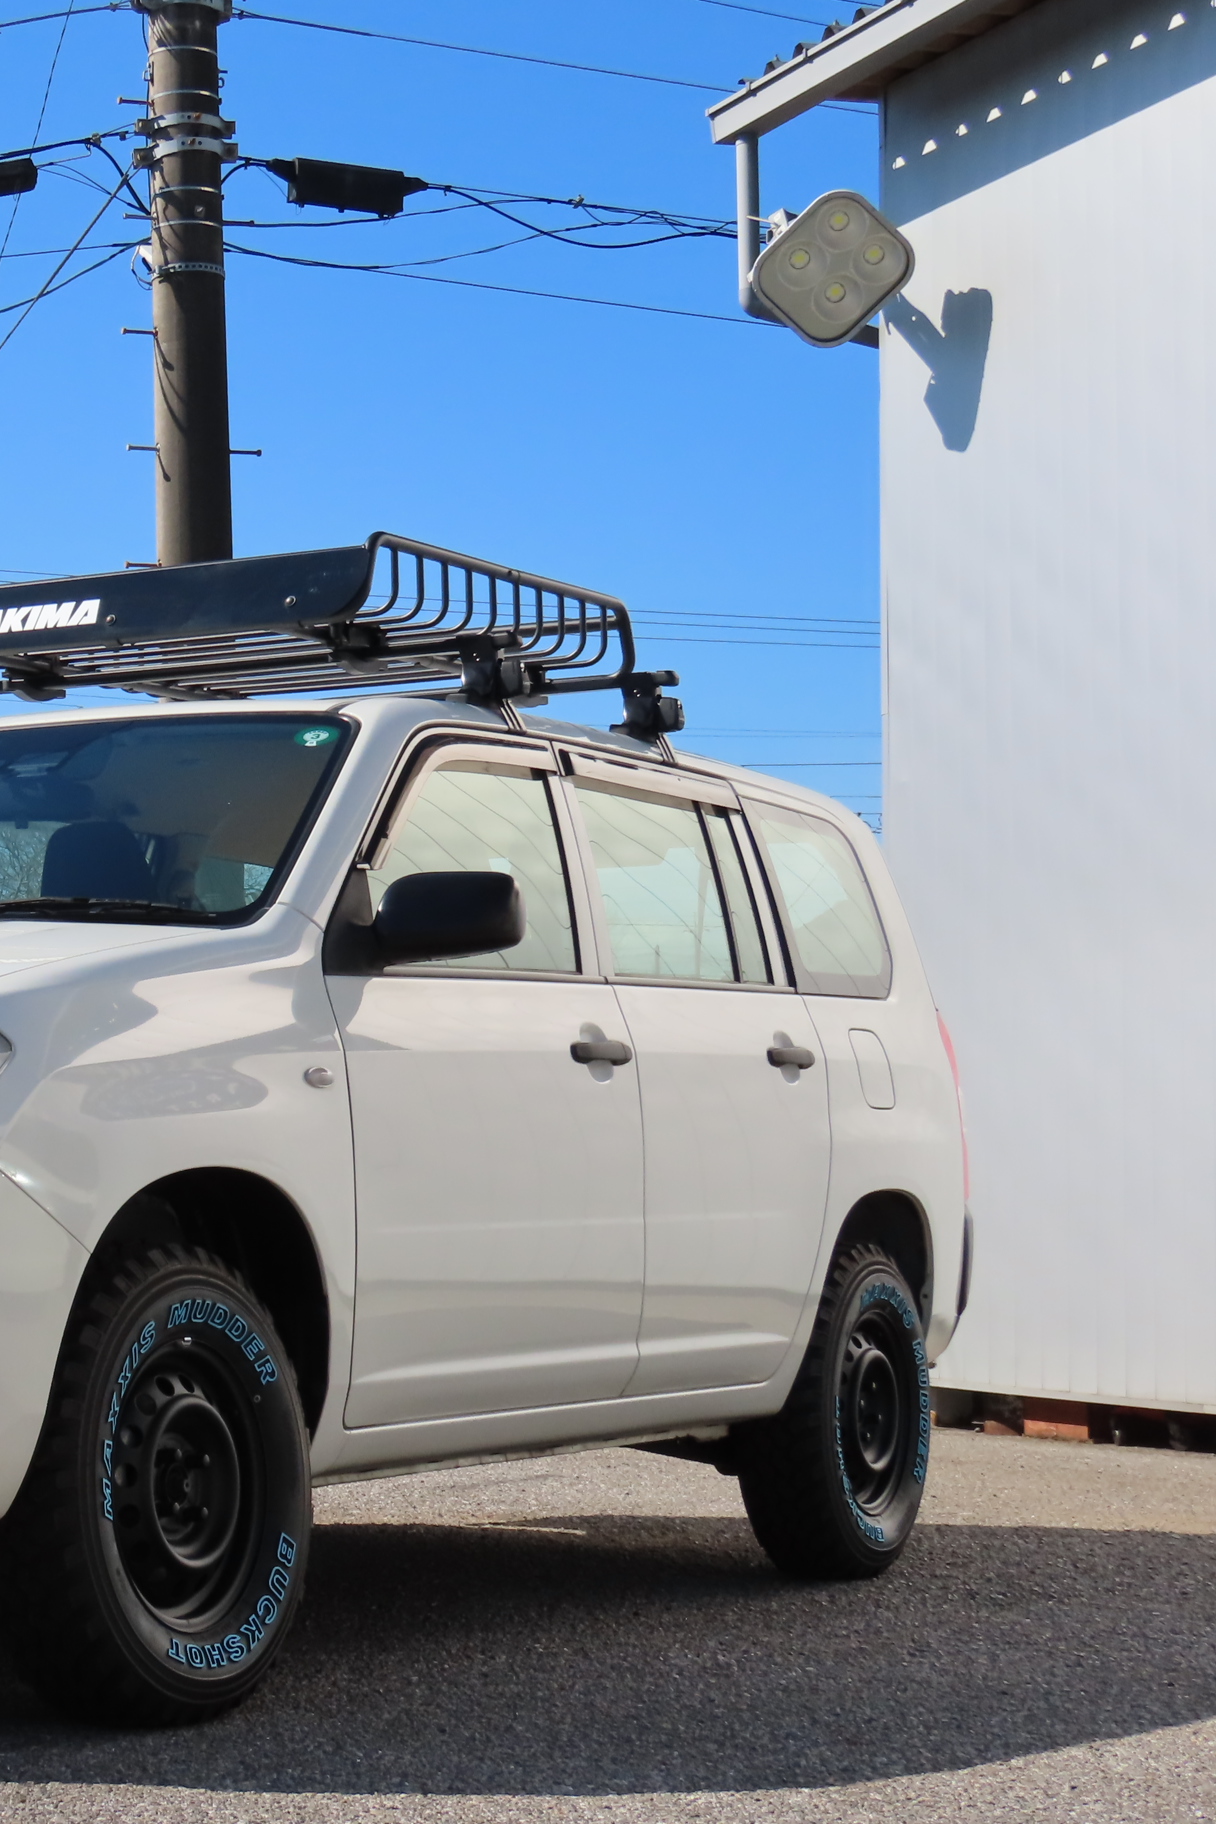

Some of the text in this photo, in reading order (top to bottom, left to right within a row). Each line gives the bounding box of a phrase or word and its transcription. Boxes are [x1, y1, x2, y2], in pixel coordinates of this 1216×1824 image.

[860, 1282, 915, 1329] MAXXIS
[102, 1299, 279, 1521] MAXXIS MUDDER
[168, 1532, 297, 1669] BUCKSHOT
